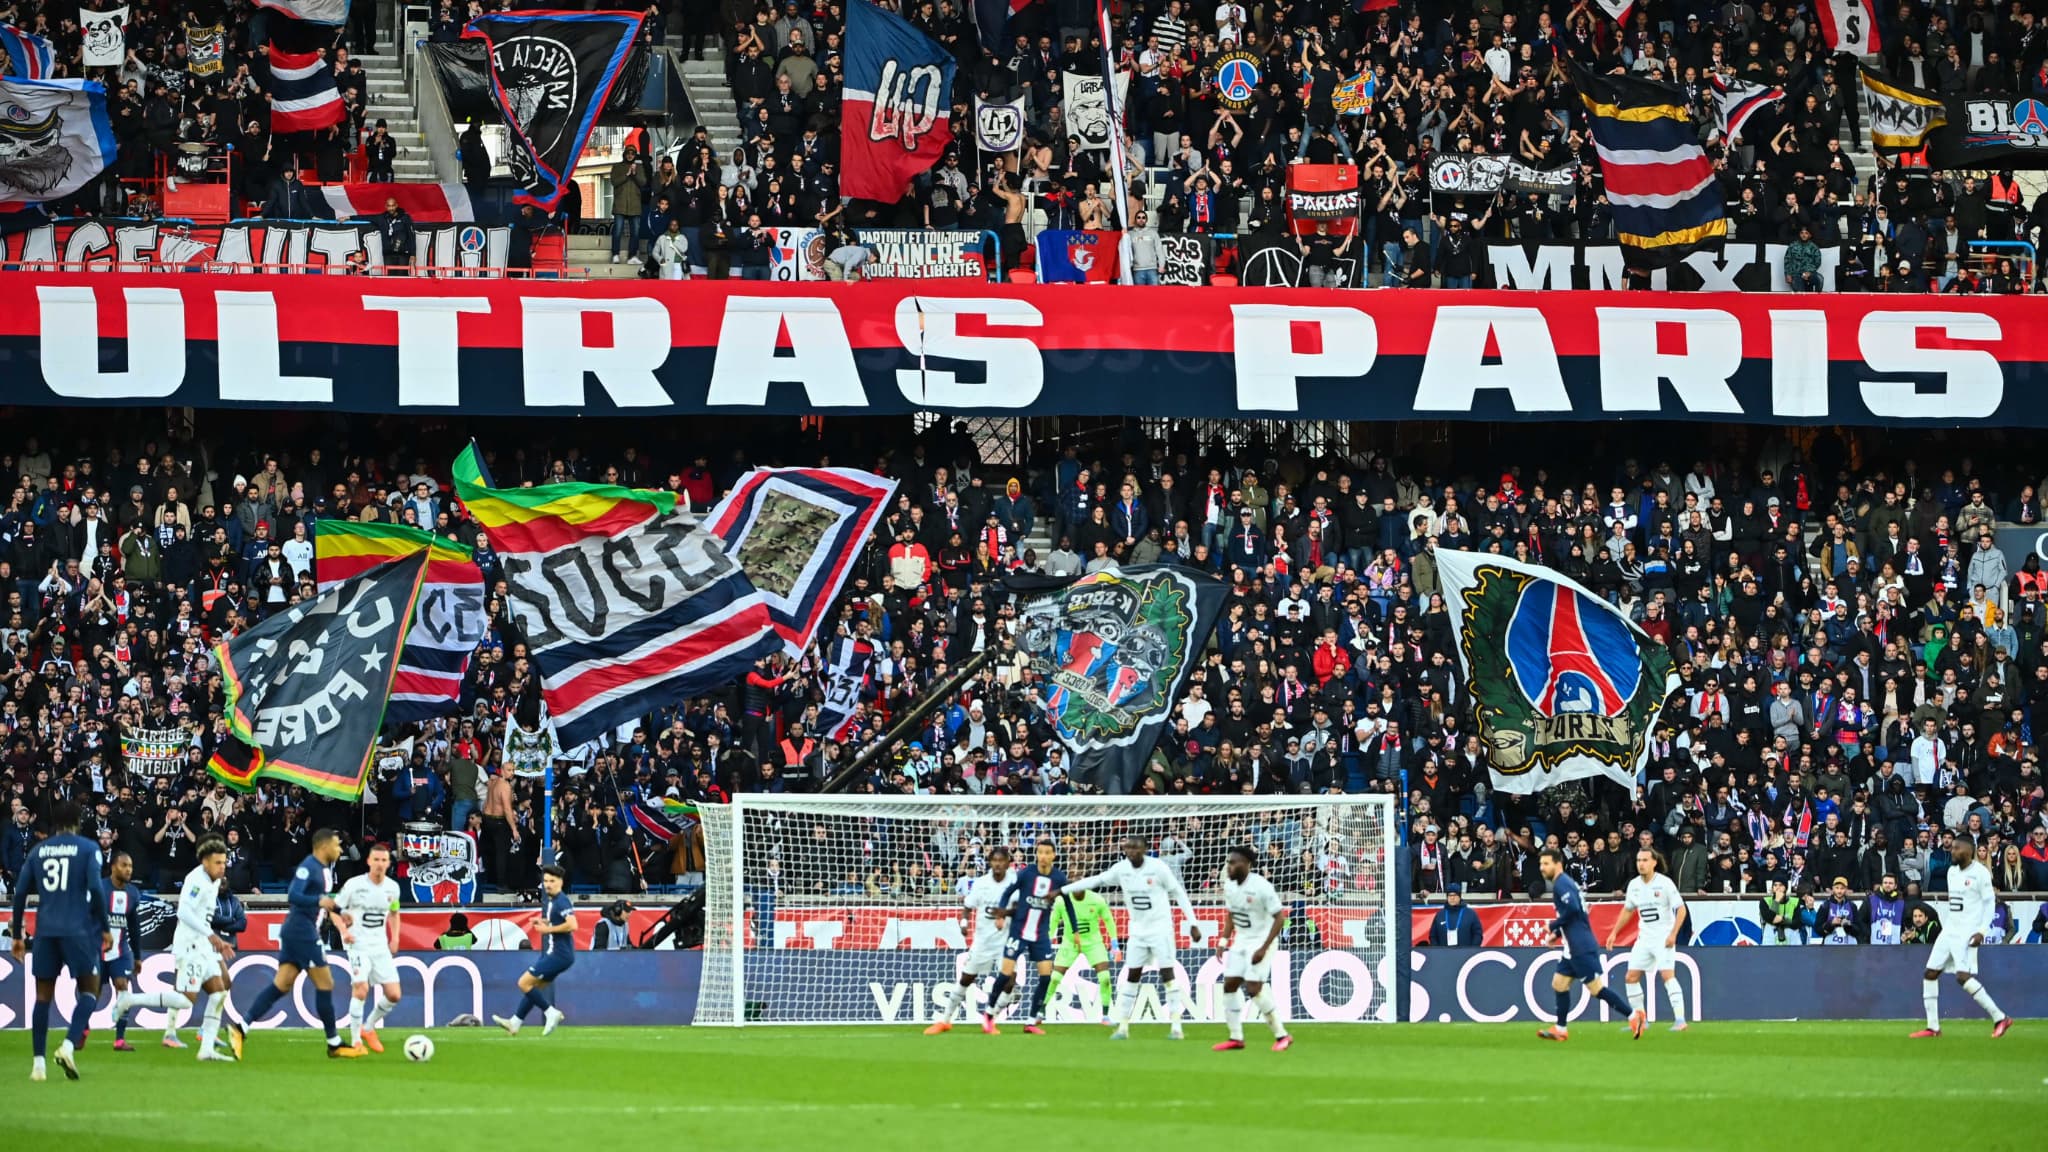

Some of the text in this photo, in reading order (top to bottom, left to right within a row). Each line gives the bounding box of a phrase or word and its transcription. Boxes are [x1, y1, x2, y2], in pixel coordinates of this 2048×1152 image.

[1508, 161, 1574, 186] PARIAS
[1291, 191, 1359, 211] PARIAS
[860, 231, 980, 243] PARTOUT ET TOUJOURS
[877, 243, 965, 265] VAINCRE
[898, 265, 920, 278] NOS
[923, 259, 981, 278] LIBERTÉS
[39, 286, 2004, 417] ULTRAS PARIS
[132, 726, 184, 742] VIRAGE
[1545, 713, 1618, 739] PARIS
[142, 744, 174, 758] 1991
[42, 857, 70, 892] 31
[186, 963, 203, 978] 33
